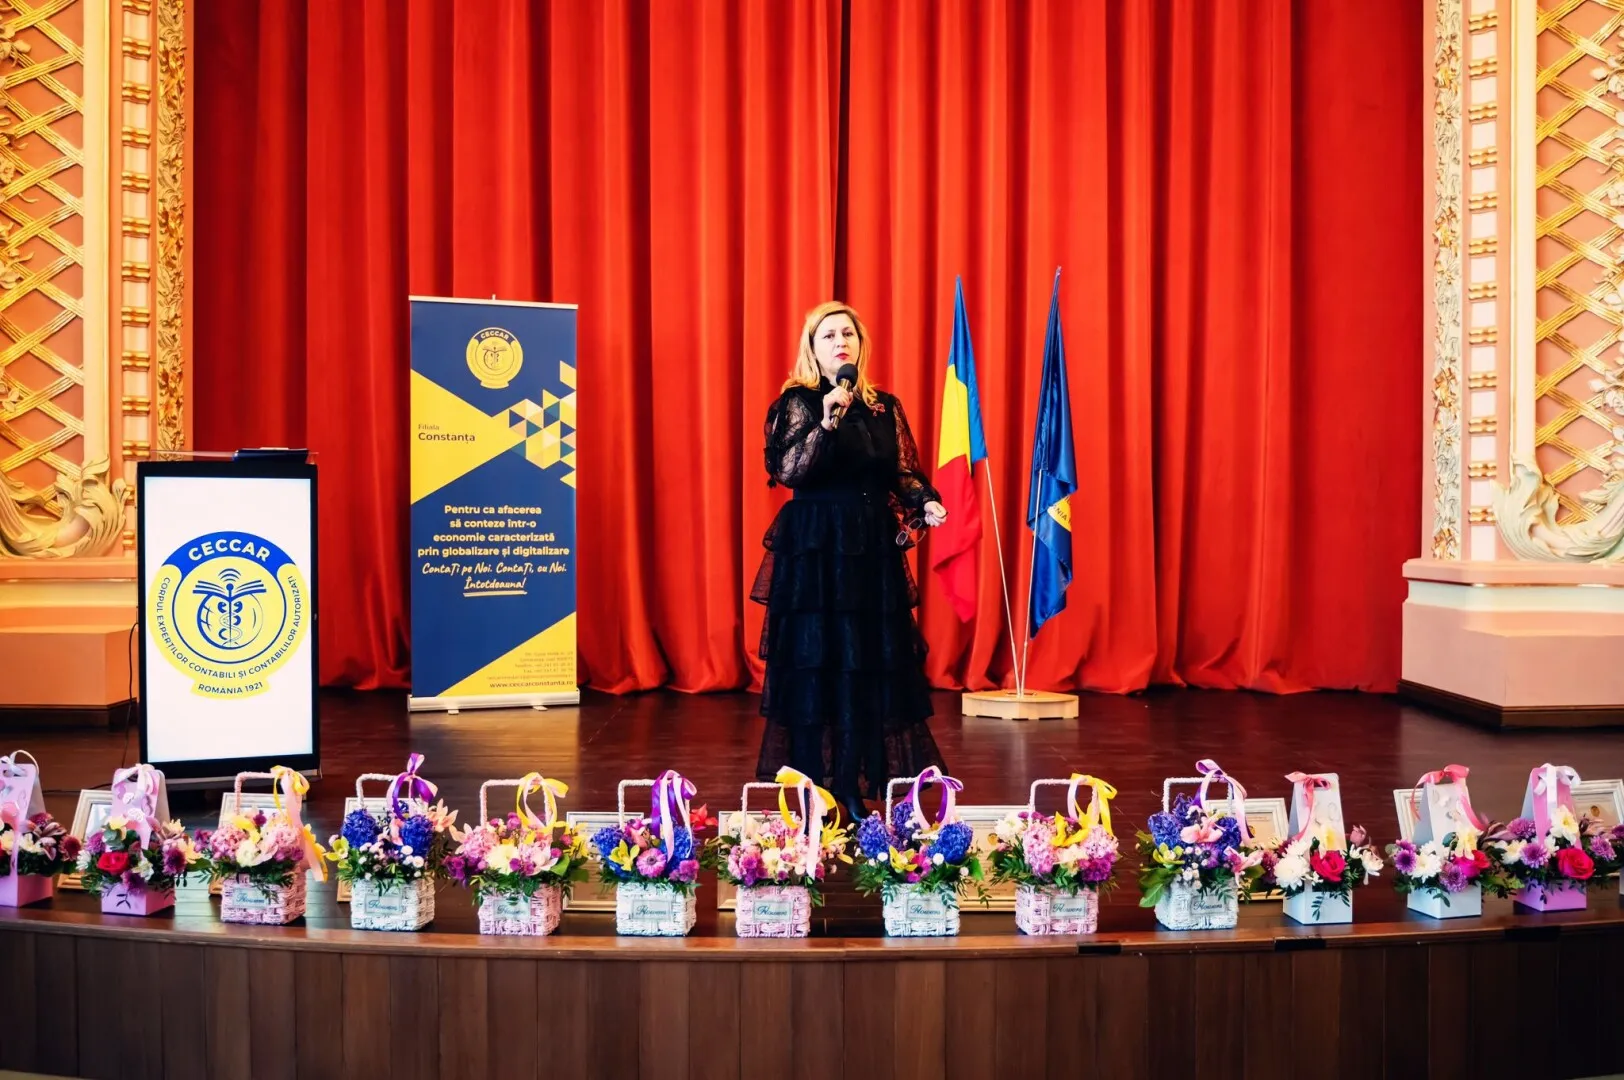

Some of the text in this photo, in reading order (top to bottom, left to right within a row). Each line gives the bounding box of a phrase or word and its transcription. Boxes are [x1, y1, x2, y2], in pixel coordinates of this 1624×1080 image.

[480, 330, 509, 340] CECCAR
[418, 432, 476, 444] Constanța
[444, 505, 481, 514] Pentru
[498, 505, 542, 515] afacerea
[449, 518, 537, 528] să conteze într-o
[433, 532, 555, 542] economie caracterizată
[188, 539, 272, 562] CECCAR
[417, 546, 570, 557] prin globalizare și digitalizare
[461, 565, 473, 575] pe
[474, 561, 493, 574] Noi.
[537, 565, 548, 573] cu
[463, 576, 527, 589] Întotdeauna!
[156, 575, 302, 680] CORPUL EXPERȚILOR CONTABILI ȘI CONTABILILOR AUTORIZAȚI
[244, 681, 264, 692] 1921
[636, 905, 667, 916] Flowers
[757, 906, 788, 916] Flowers
[910, 904, 941, 915] Flowers
[1053, 902, 1083, 913] Flowers
